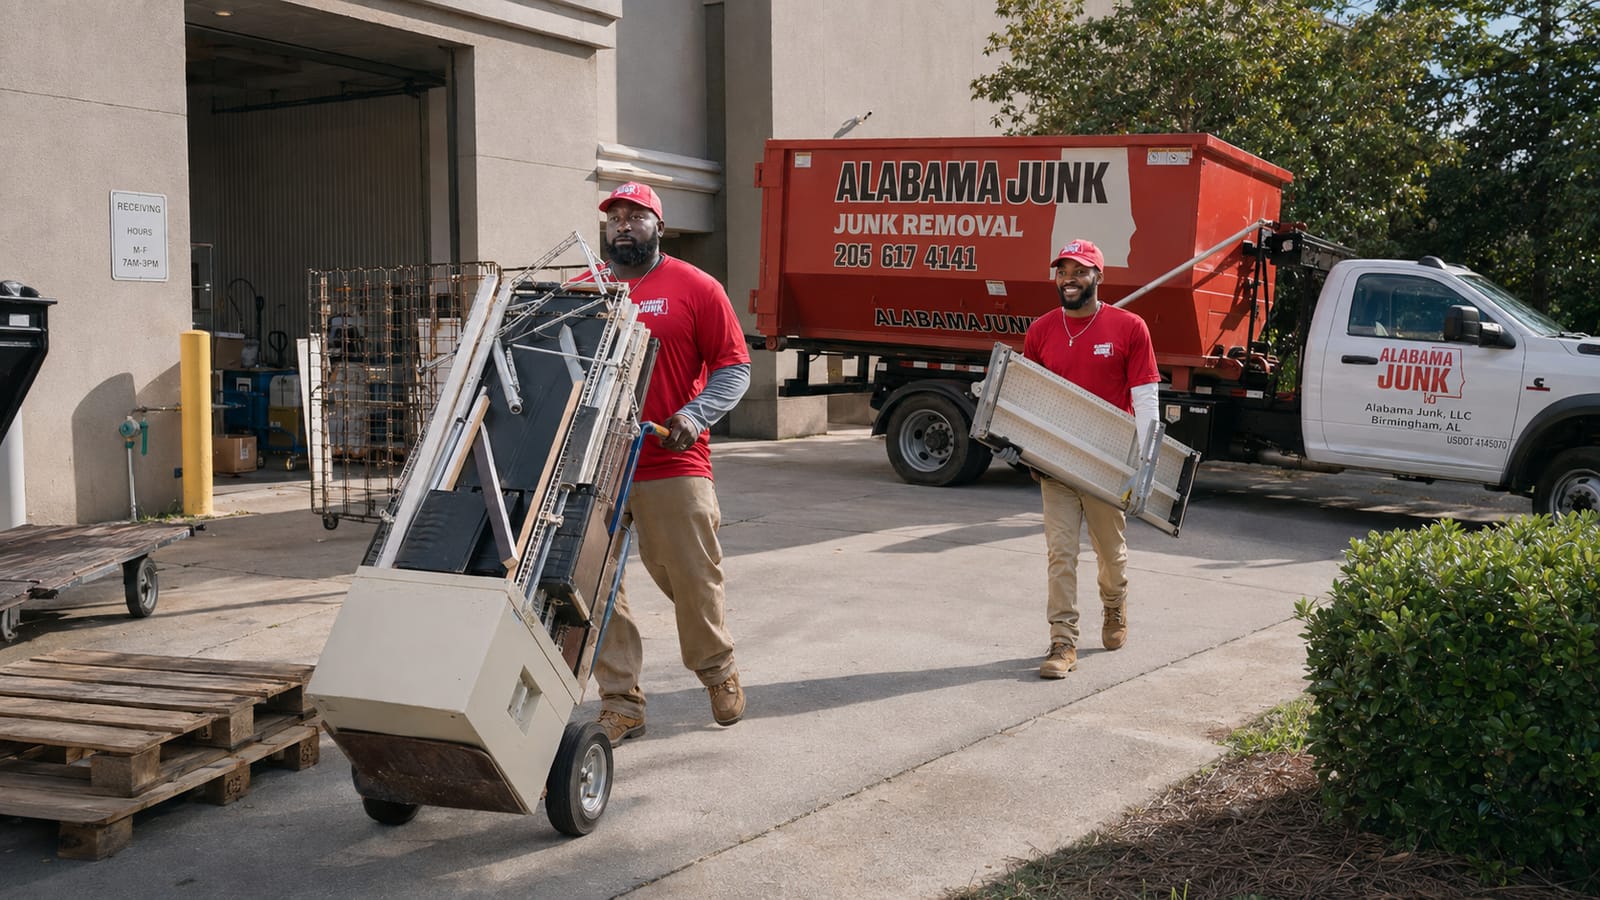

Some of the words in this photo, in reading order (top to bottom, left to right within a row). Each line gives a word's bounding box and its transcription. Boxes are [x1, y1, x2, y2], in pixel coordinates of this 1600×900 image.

[834, 160, 1002, 205] ALABAMA
[1006, 160, 1111, 206] JUNK
[117, 202, 161, 214] RECEIVING
[127, 227, 153, 237] HOURS
[833, 213, 898, 235] JUNK
[902, 214, 1023, 237] REMOVAL
[133, 246, 148, 254] M-F
[834, 243, 872, 268] 205
[880, 244, 917, 269] 617
[924, 245, 977, 272] 4141
[122, 258, 159, 268] 7AM-3PM
[1379, 347, 1453, 367] ALABAMA
[1377, 363, 1451, 394] JUNK
[1364, 403, 1413, 416] Alabama
[1417, 407, 1446, 420] Junk,
[1450, 410, 1472, 421] LLC
[1371, 415, 1442, 432] Birmingham,
[1446, 422, 1462, 432] AL
[1446, 435, 1474, 447] USDOT
[1475, 438, 1508, 450] 4145070
